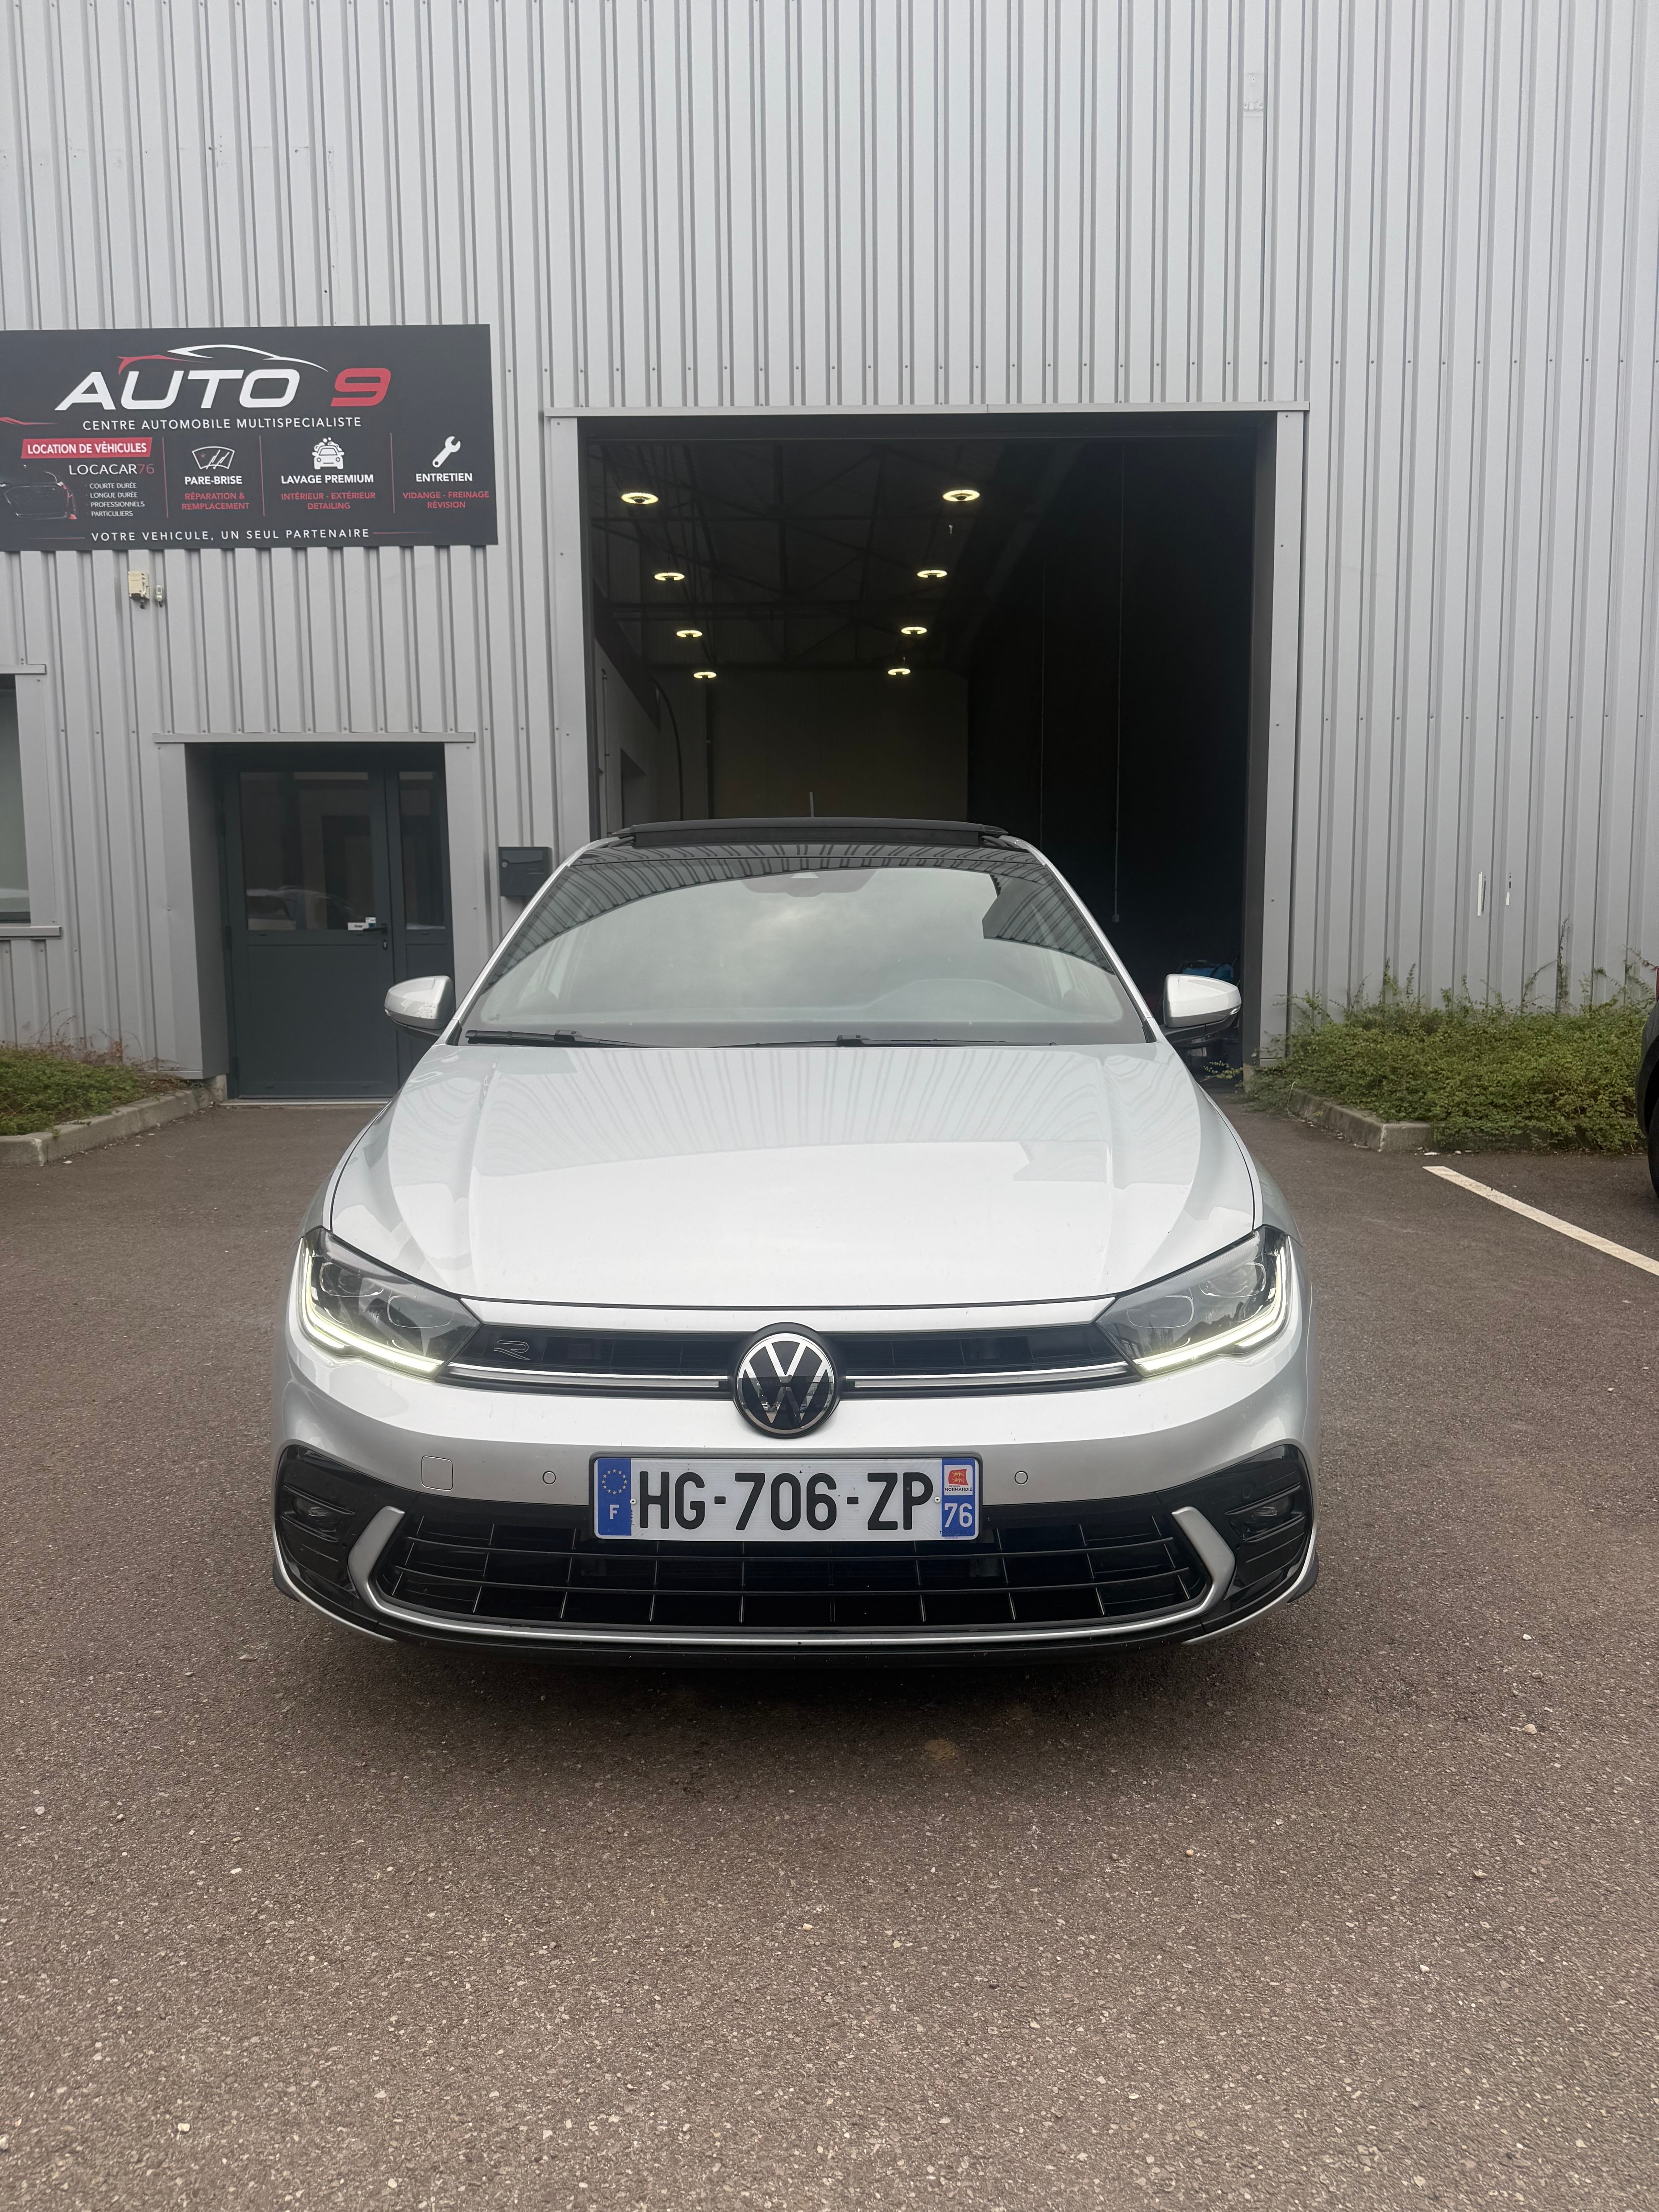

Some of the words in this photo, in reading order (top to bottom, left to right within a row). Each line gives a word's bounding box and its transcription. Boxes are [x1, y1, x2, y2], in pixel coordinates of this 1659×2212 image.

[55, 369, 300, 410] AUTO
[331, 368, 391, 407] 9
[83, 421, 135, 430] CENTRE
[142, 419, 230, 429] AUTOMOBILE
[237, 417, 361, 428] MULTISPECIALISTE
[28, 444, 76, 454] LOCATION
[79, 444, 92, 453] DE
[94, 441, 146, 453] VÉHICULES
[185, 476, 242, 484] PARE-BRISE
[282, 475, 321, 484] LAVAGE
[325, 474, 373, 483] PREMIUM
[416, 473, 472, 481] ENTRETIEN
[331, 491, 376, 499] EXTÉRIEUR
[182, 502, 249, 510] REMPLACEMENT
[427, 500, 465, 508] RÉVISION
[92, 532, 135, 541] VOTRE
[142, 531, 213, 540] VEHICULE,
[222, 531, 239, 539] UN
[247, 531, 278, 539] SEUL
[287, 529, 369, 538] PARTENAIRE
[639, 1471, 934, 1531] HG-706-ZP
[610, 1504, 619, 1520] F
[944, 1503, 972, 1527] 76
